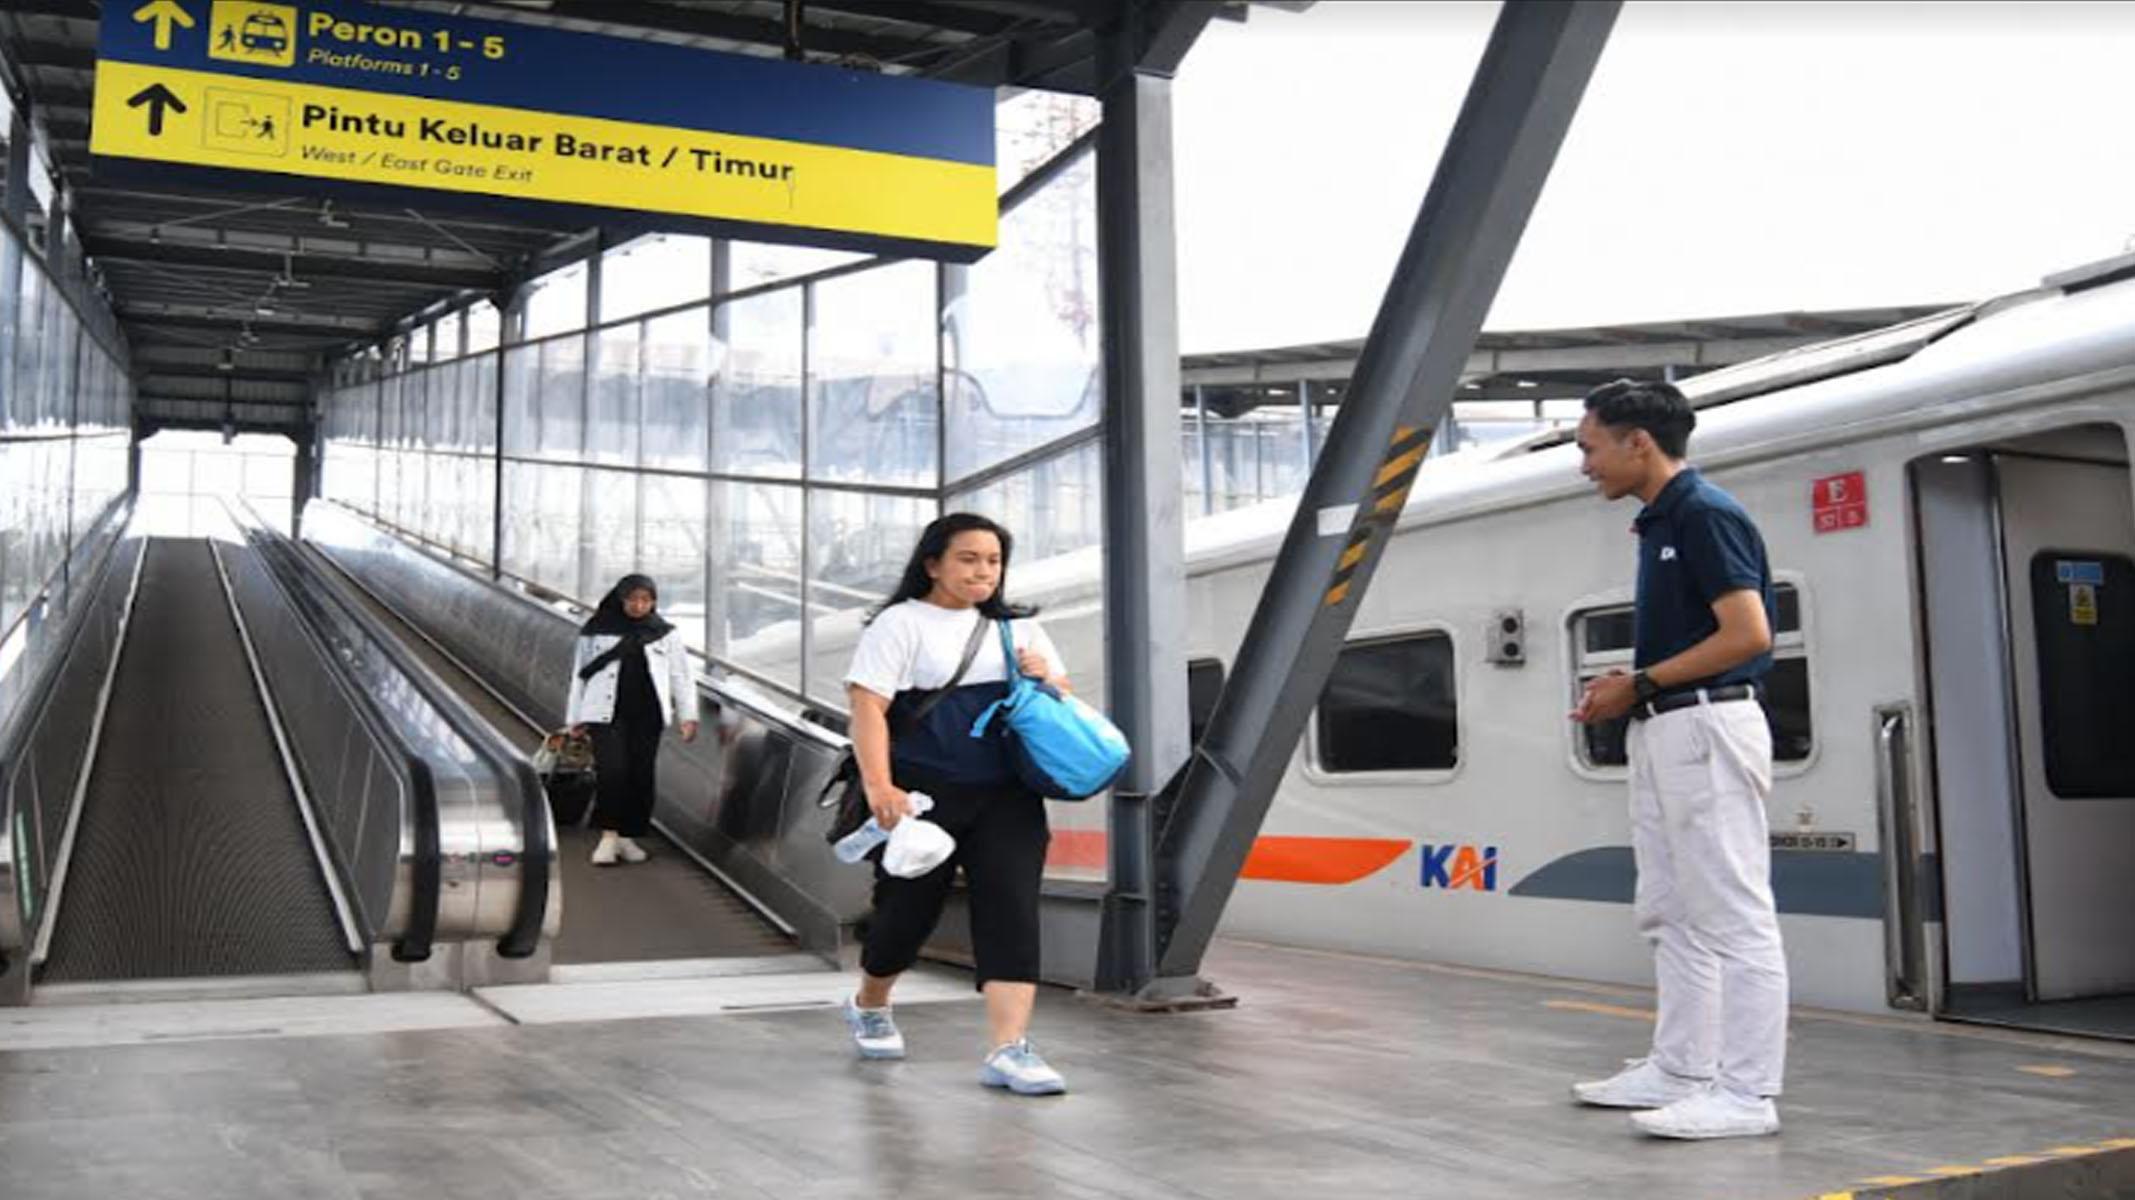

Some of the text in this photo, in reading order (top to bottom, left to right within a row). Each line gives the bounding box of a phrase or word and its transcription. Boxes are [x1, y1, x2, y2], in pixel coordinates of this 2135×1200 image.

[308, 12, 421, 50] Peron
[307, 49, 413, 76] Platforms
[302, 104, 405, 138] Pintu
[419, 119, 542, 153] Keluar
[555, 133, 650, 167] Barat
[690, 150, 794, 180] Timur
[301, 145, 356, 164] West
[380, 153, 427, 172] East
[436, 158, 486, 178] Gate
[494, 164, 533, 183] Exit
[1421, 844, 1498, 891] KAI
